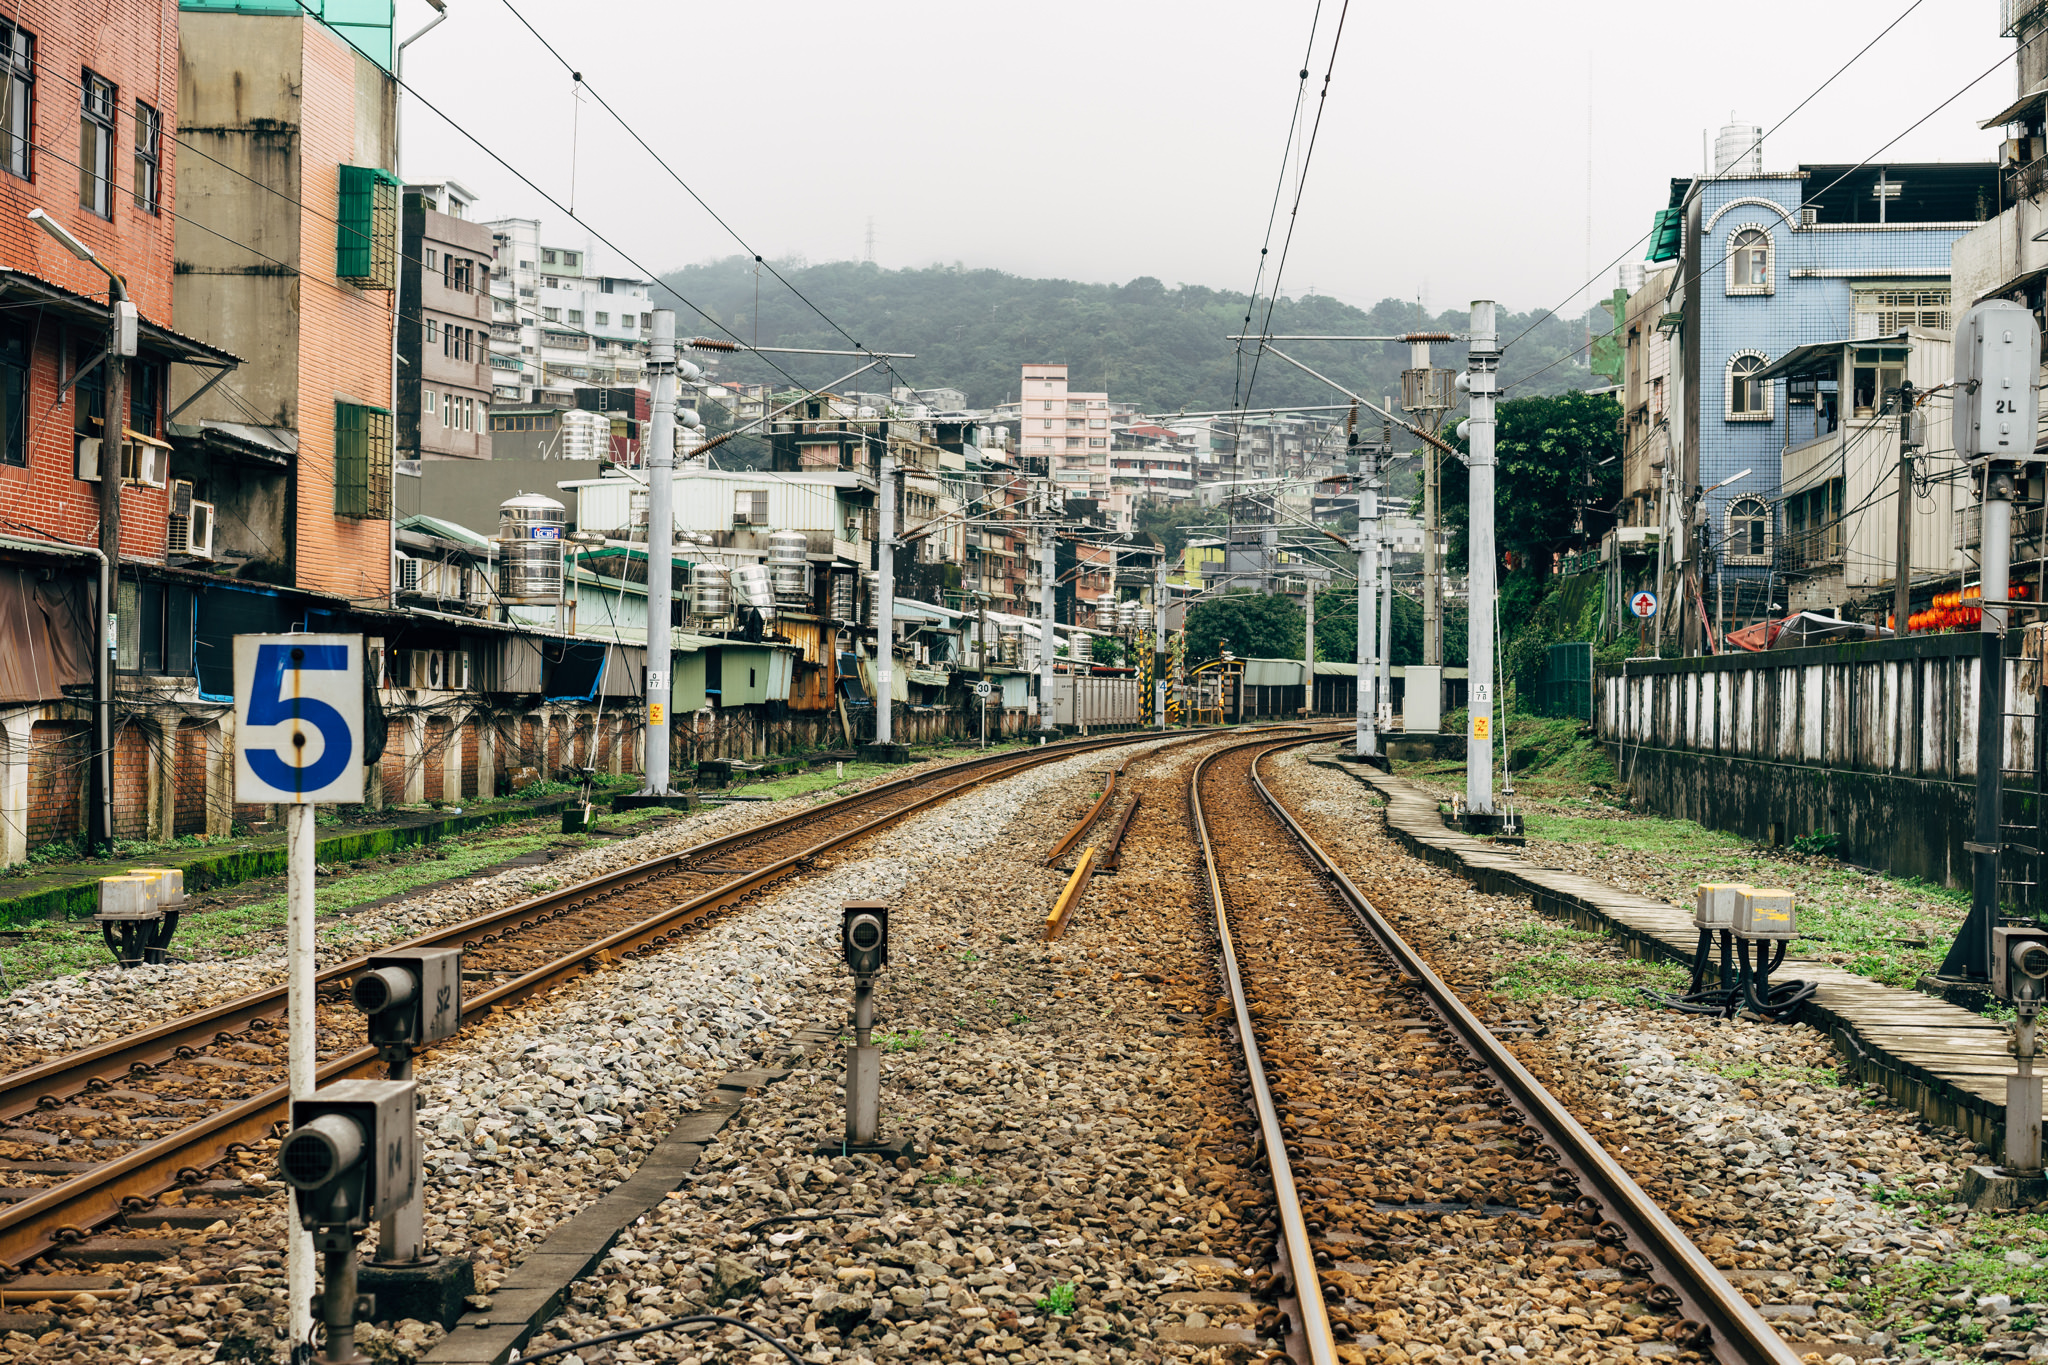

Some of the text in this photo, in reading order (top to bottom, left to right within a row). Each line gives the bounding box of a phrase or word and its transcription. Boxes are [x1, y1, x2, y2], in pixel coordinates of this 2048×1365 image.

[1996, 400, 2016, 413] 2L
[978, 684, 988, 692] 30
[1160, 681, 1166, 690] 4
[244, 644, 352, 793] 5
